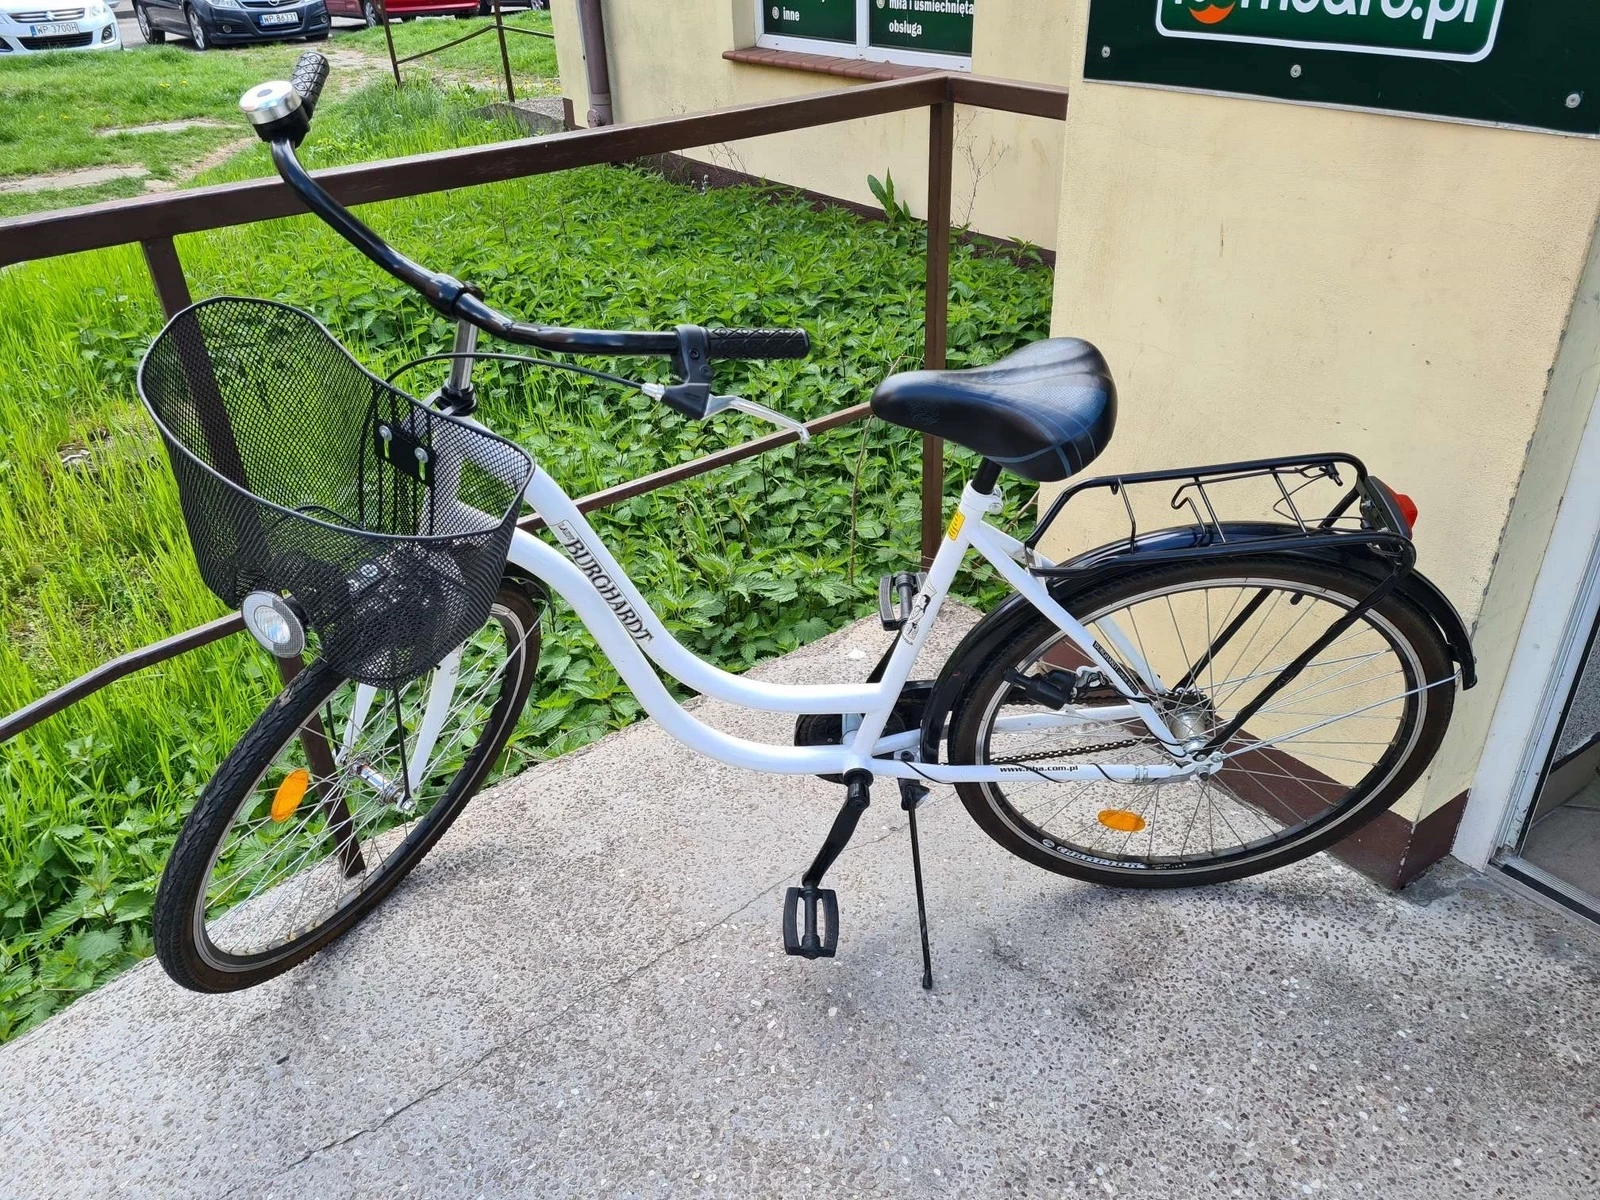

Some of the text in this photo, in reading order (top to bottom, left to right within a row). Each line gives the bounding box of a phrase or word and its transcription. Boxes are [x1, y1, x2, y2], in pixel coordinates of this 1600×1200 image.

[783, 6, 800, 21] inne
[36, 25, 49, 35] WP
[888, 19, 923, 37] obsługa
[564, 539, 655, 642] BURGHARDT
